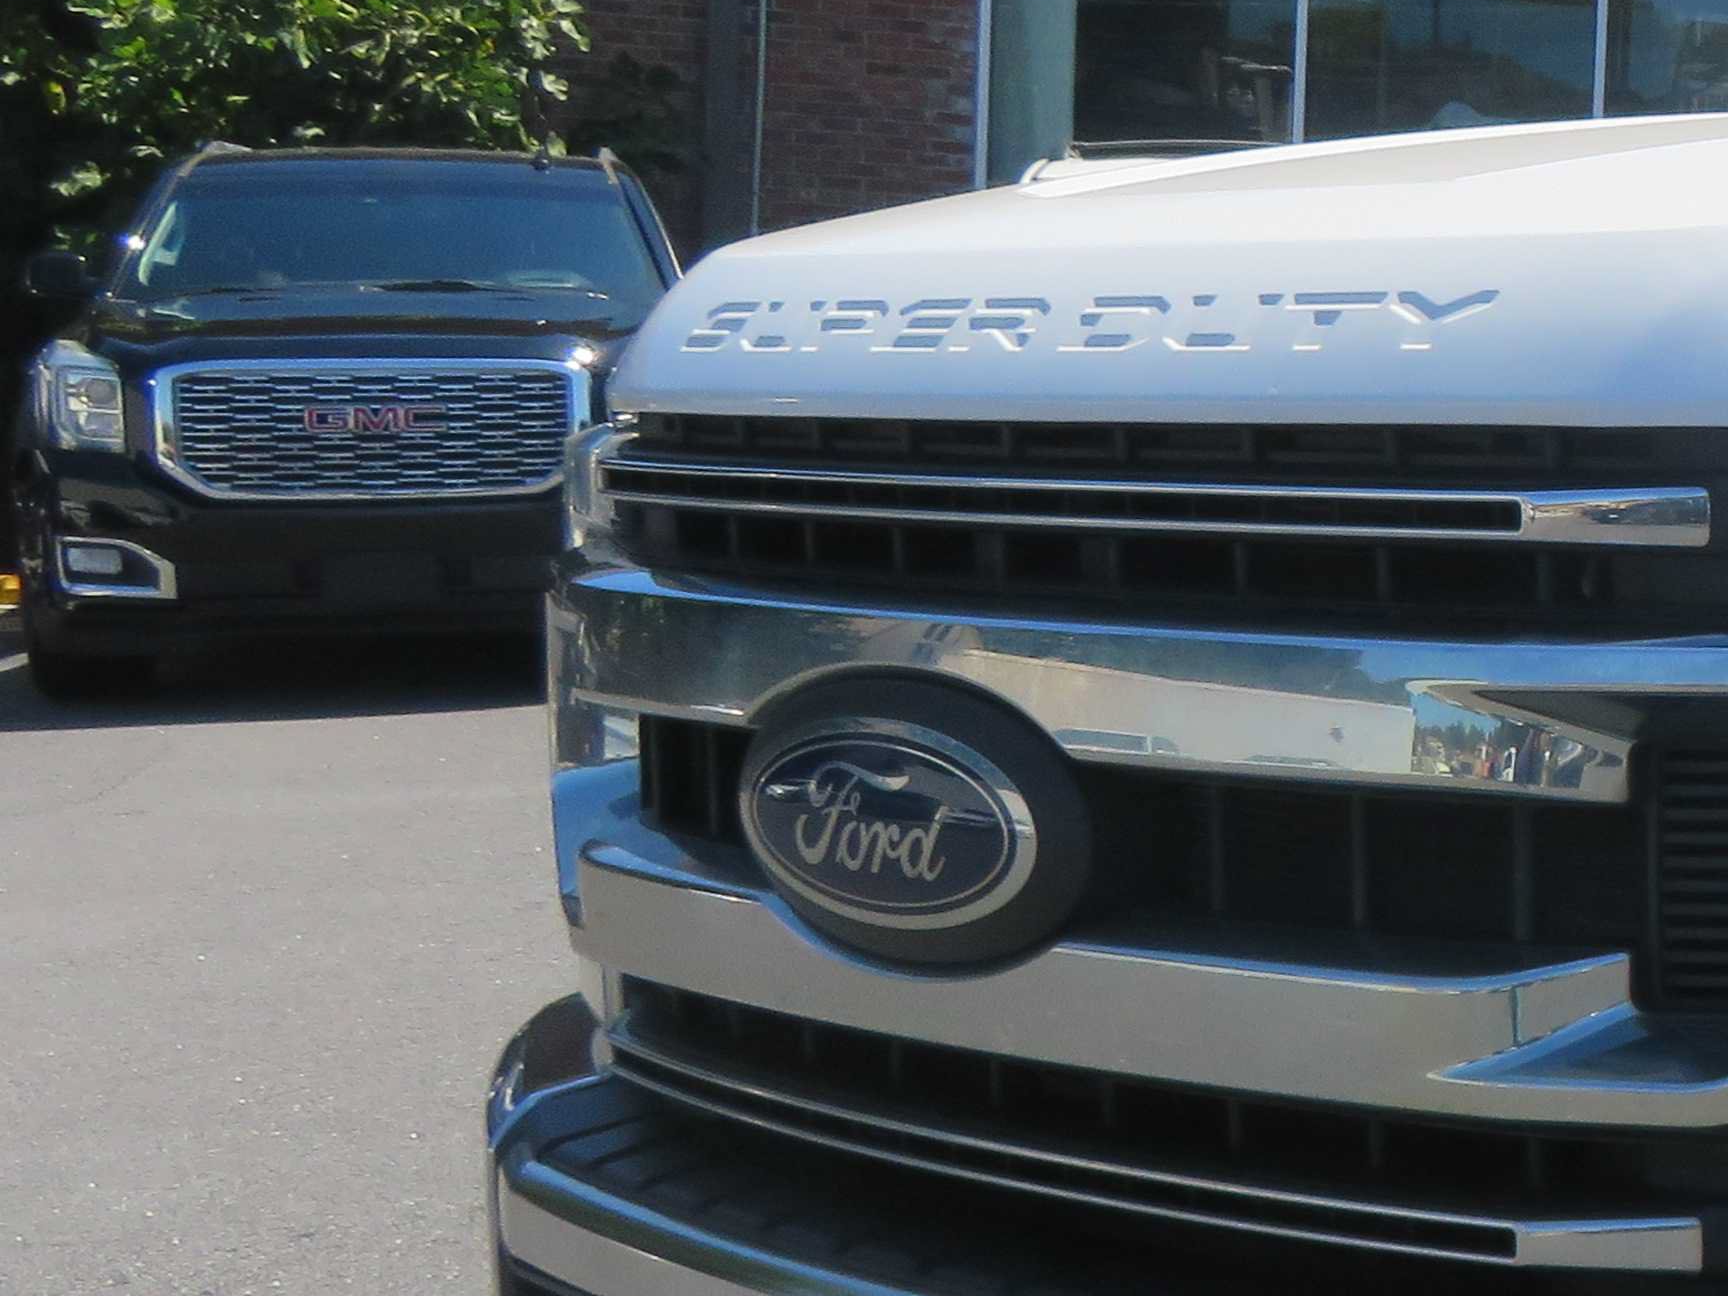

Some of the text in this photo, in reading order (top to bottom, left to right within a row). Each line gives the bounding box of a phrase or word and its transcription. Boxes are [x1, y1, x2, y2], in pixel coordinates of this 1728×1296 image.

[680, 289, 1502, 353] SUPER DUTY
[304, 404, 447, 433] GMC
[795, 760, 946, 883] Ford
